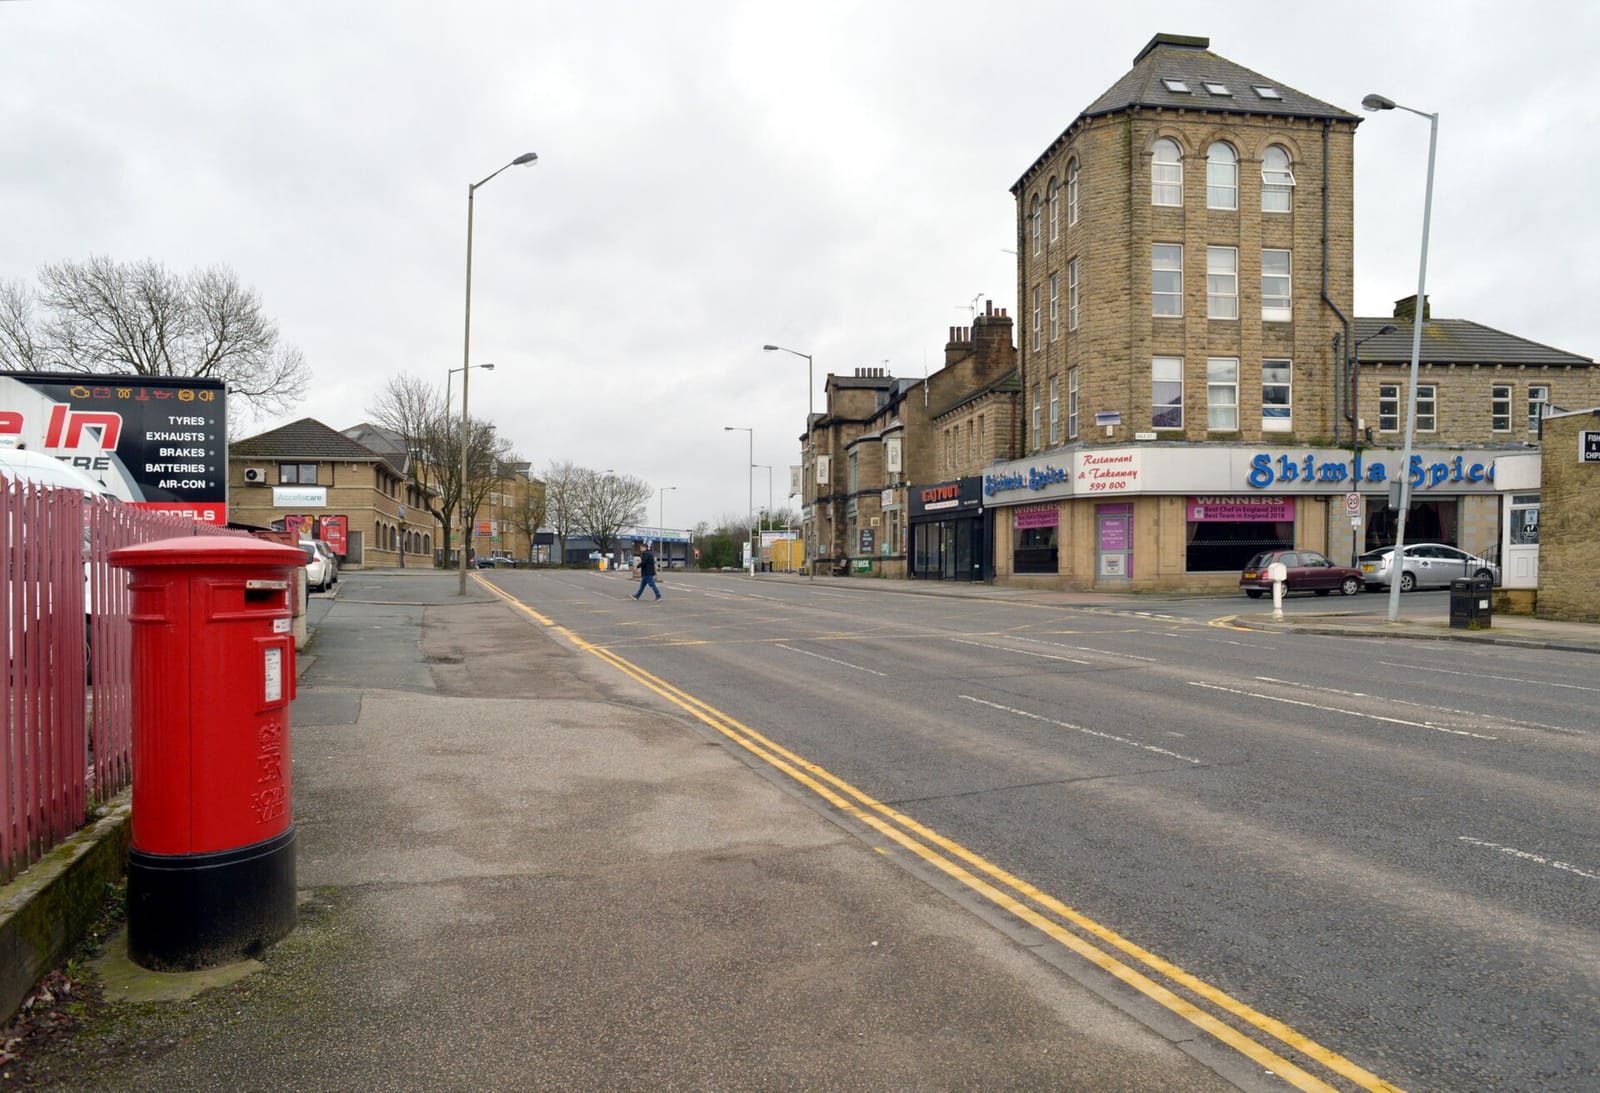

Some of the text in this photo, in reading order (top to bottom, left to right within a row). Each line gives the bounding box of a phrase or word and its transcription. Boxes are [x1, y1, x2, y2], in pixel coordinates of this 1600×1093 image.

[168, 416, 205, 426] TYRES
[44, 405, 121, 449] In
[146, 431, 205, 441] EXHAUSTS
[159, 448, 205, 457] BRAKES
[1083, 455, 1132, 466] Restaurant
[145, 464, 205, 473] BATTERIES
[1249, 454, 1495, 488] Shimla Spic
[1089, 468, 1138, 480] Takeaway
[158, 480, 206, 489] AIR-CON
[1089, 481, 1126, 491] 599 800
[1196, 496, 1285, 505] WINNERS
[1014, 503, 1059, 514] WINNERS
[1243, 506, 1268, 514] England
[152, 510, 216, 521] ODELS
